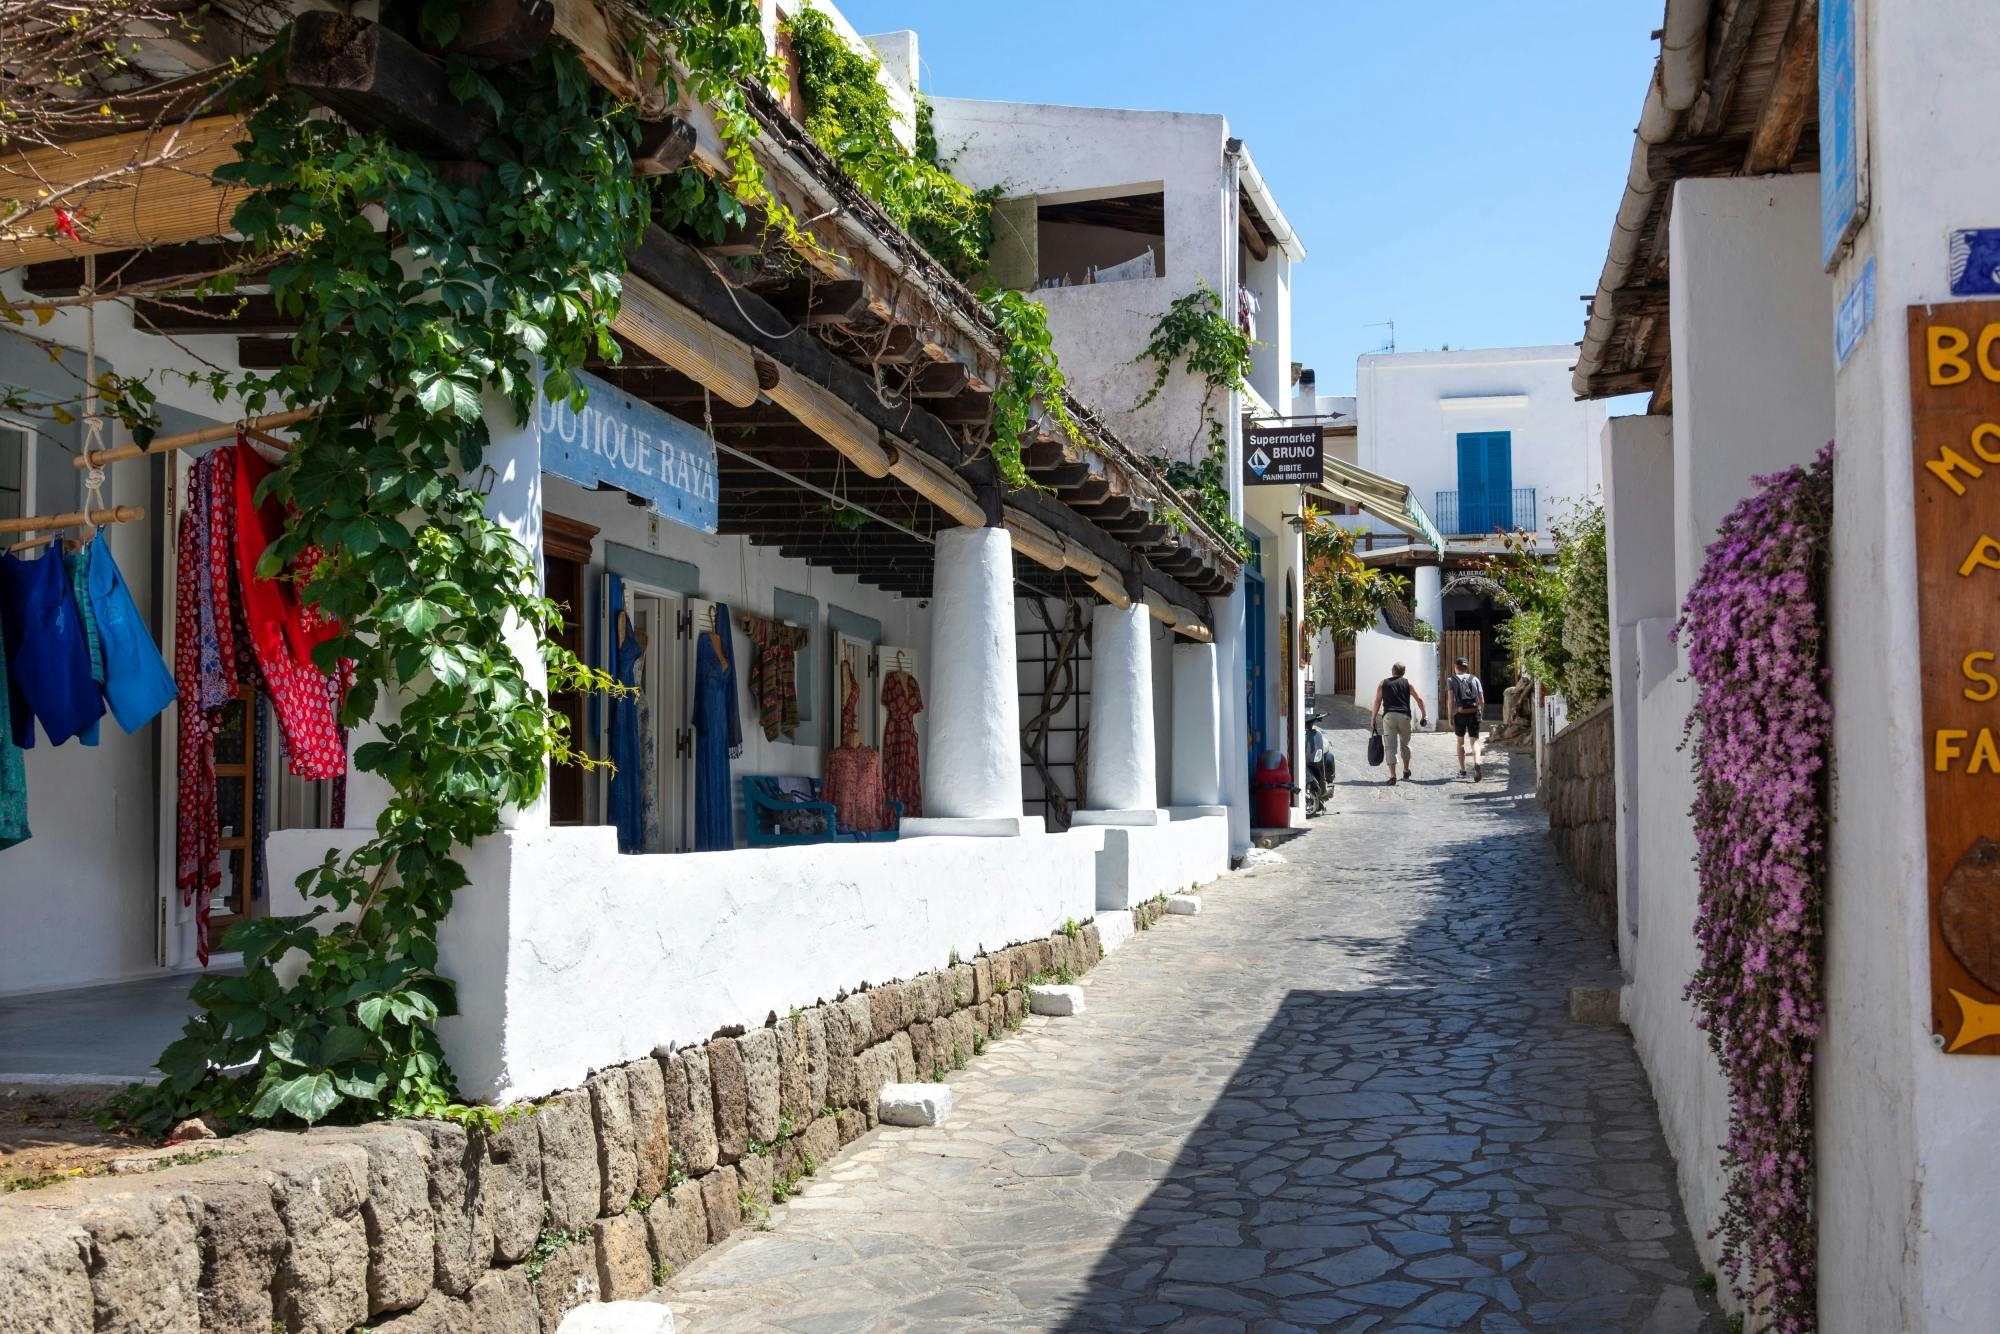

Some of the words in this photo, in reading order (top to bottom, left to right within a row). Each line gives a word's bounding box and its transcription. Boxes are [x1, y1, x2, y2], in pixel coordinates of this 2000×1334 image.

[1249, 433, 1315, 446] Supermarket
[540, 398, 653, 477] OUTIQUE
[660, 439, 715, 504] RAYA
[1272, 446, 1315, 459] BRUNO
[1278, 464, 1302, 472] BIBITE
[1285, 472, 1318, 480] IMBOTTITI
